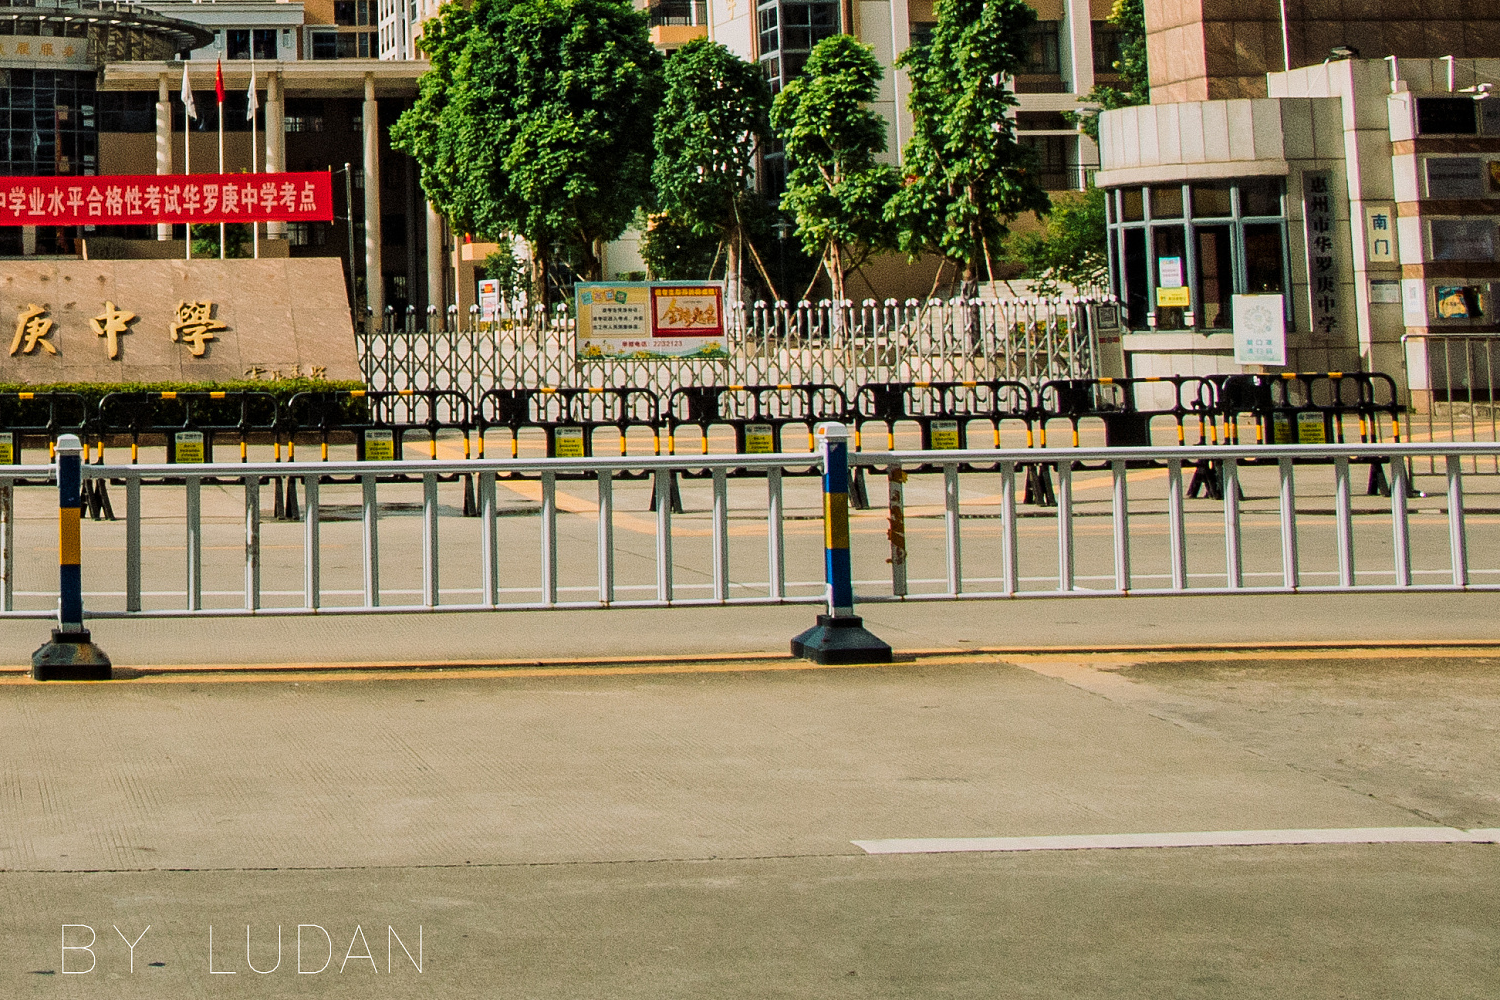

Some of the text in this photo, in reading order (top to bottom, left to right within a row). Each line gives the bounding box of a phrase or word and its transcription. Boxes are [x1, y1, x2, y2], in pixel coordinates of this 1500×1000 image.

[1311, 177, 1337, 333] 惠州市华罗庚中学
[1371, 214, 1390, 255] 南门
